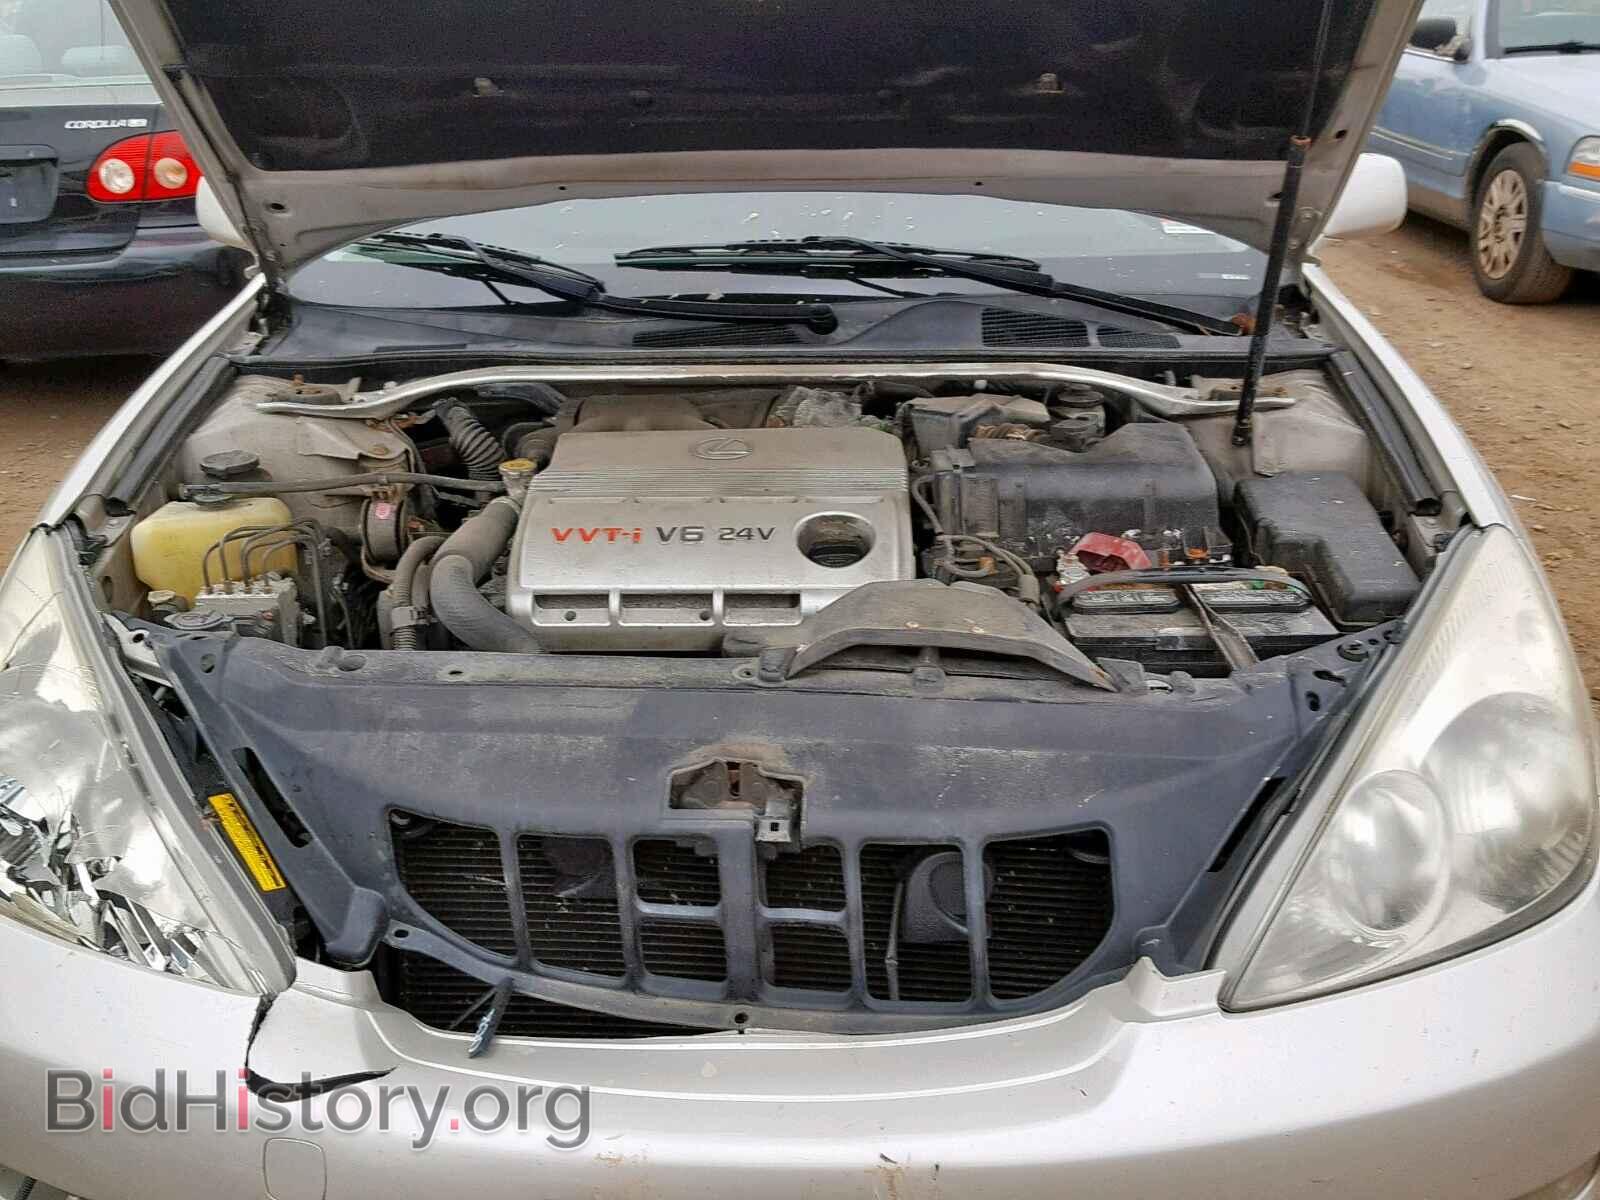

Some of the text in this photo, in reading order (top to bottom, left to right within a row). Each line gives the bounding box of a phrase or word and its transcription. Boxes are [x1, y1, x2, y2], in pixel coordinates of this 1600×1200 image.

[551, 525, 776, 543] VVT-i V6 24V
